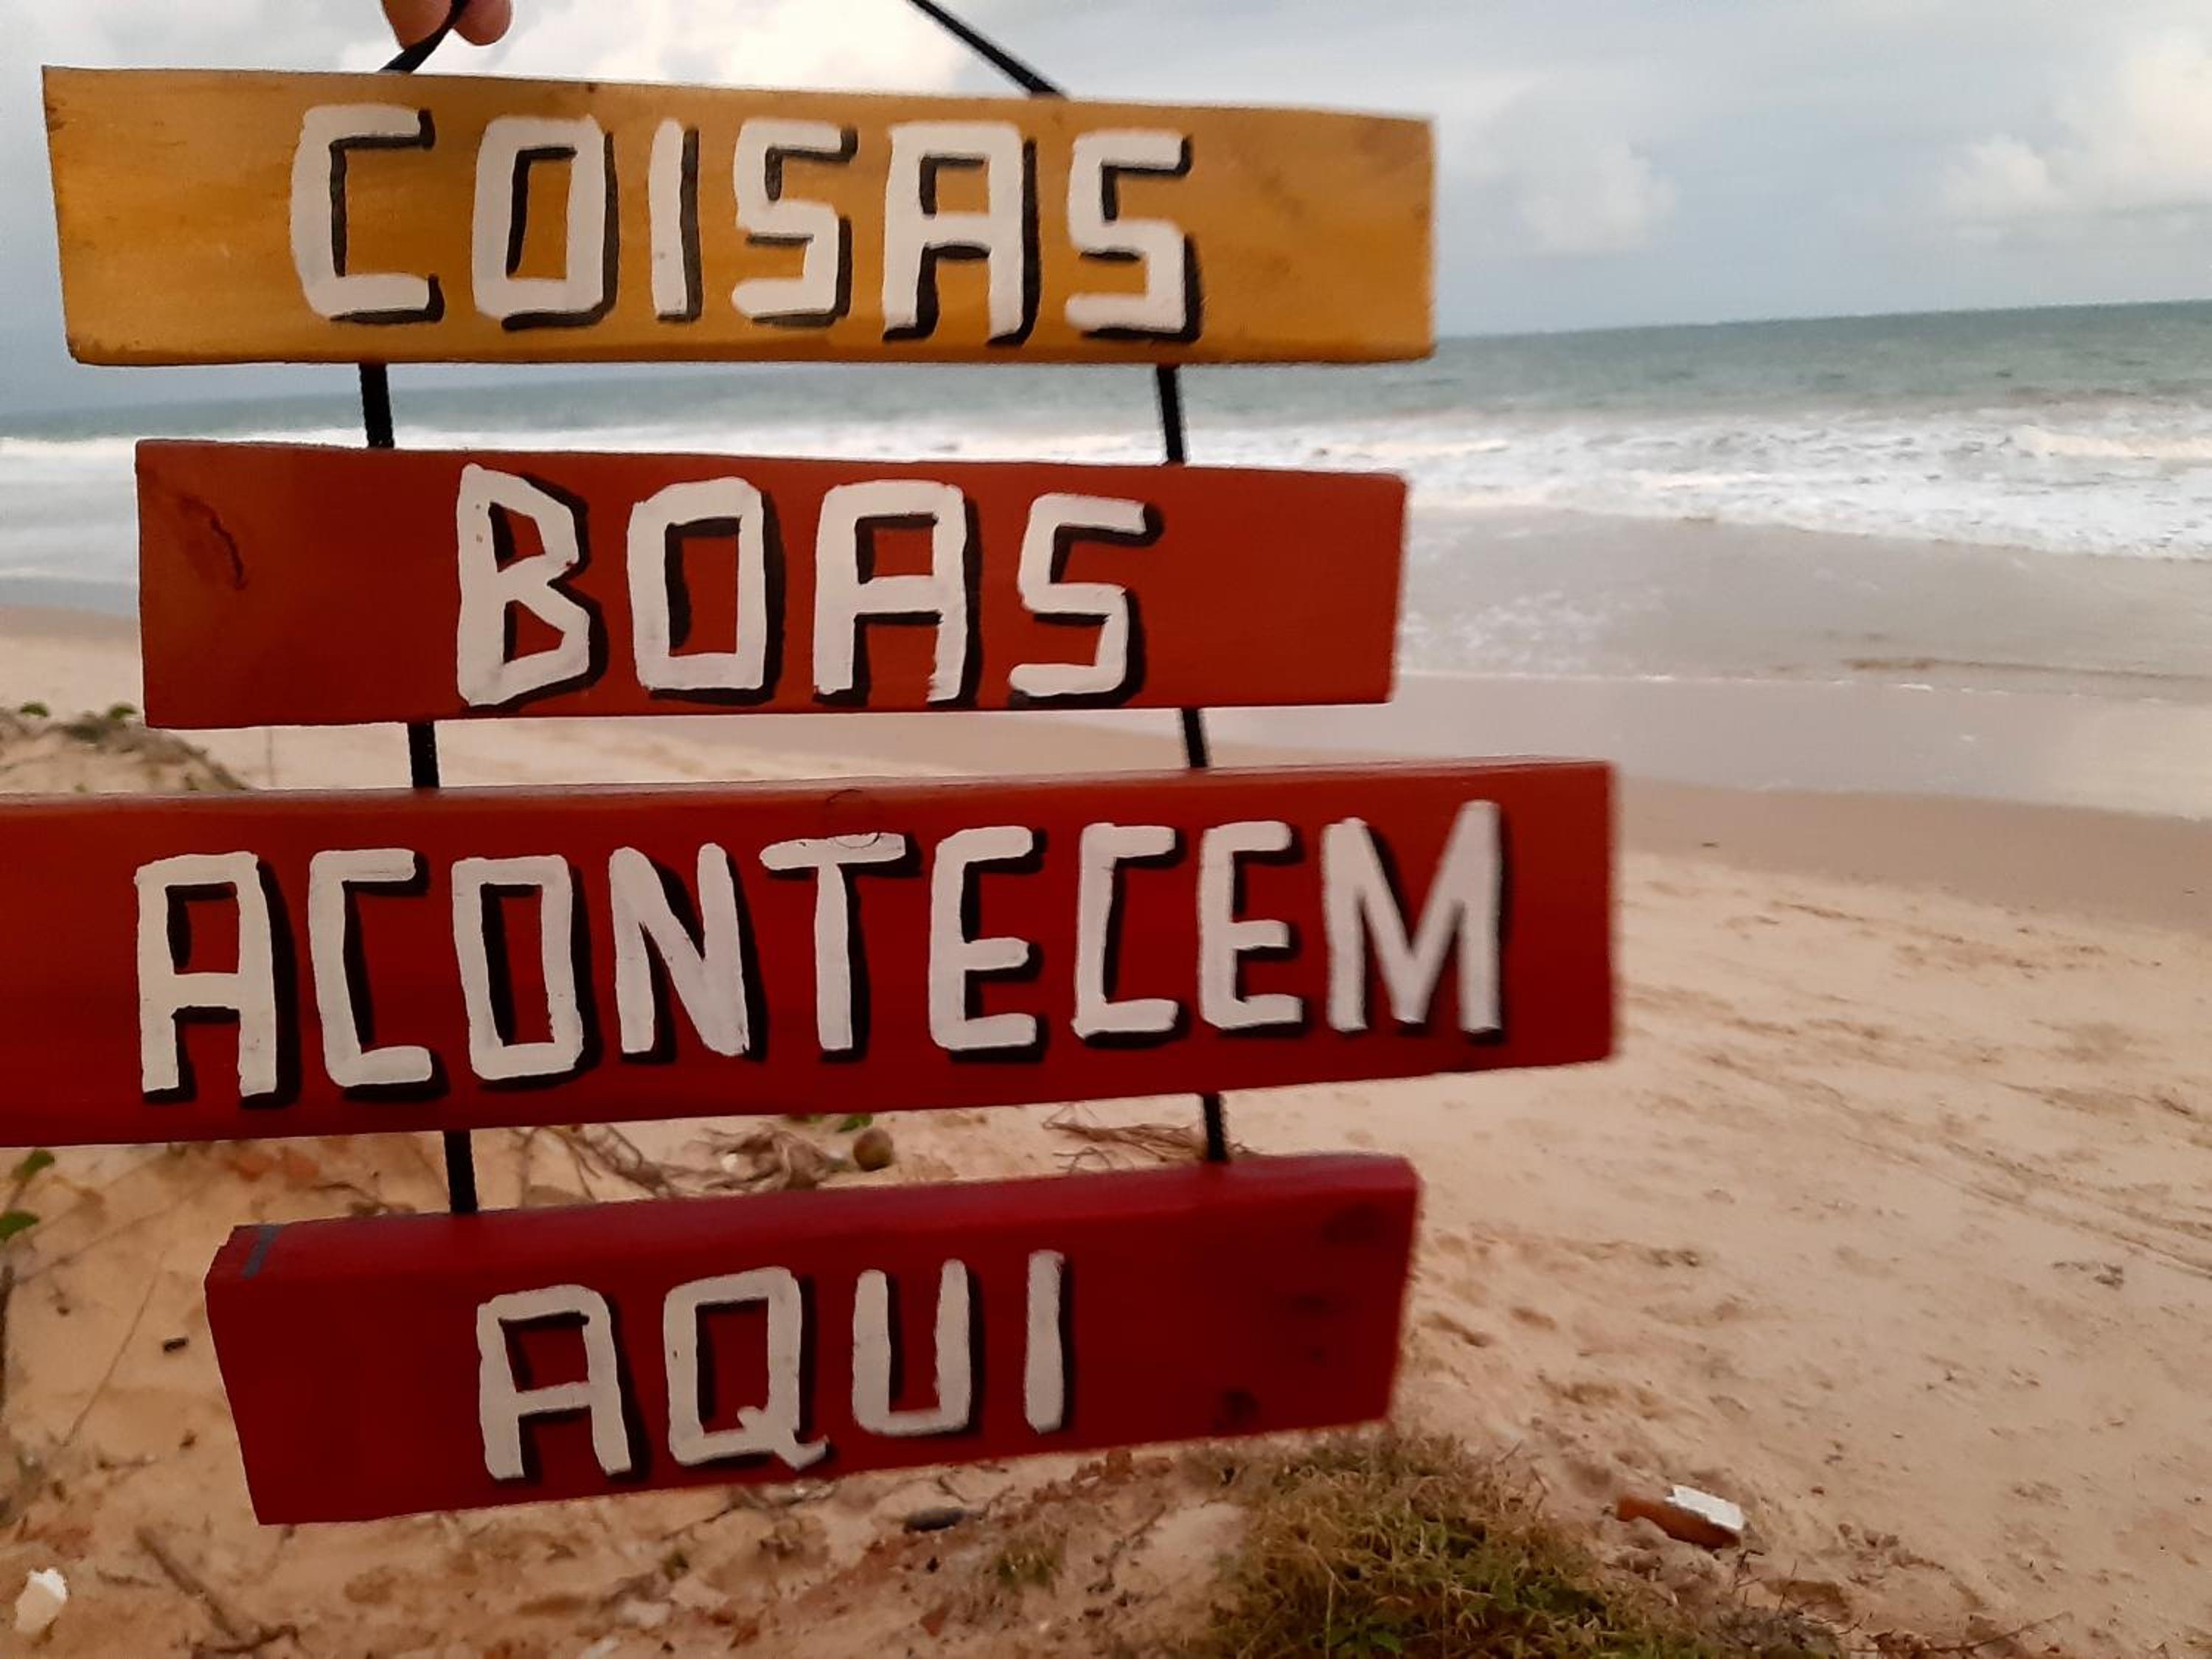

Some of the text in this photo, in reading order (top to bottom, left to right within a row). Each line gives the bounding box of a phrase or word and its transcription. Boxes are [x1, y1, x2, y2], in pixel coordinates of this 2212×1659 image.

[289, 102, 1196, 338] COISAS
[456, 463, 1158, 708] BOAS
[134, 801, 1501, 1099] ACONTECEM
[476, 1249, 1068, 1481] AQUI
